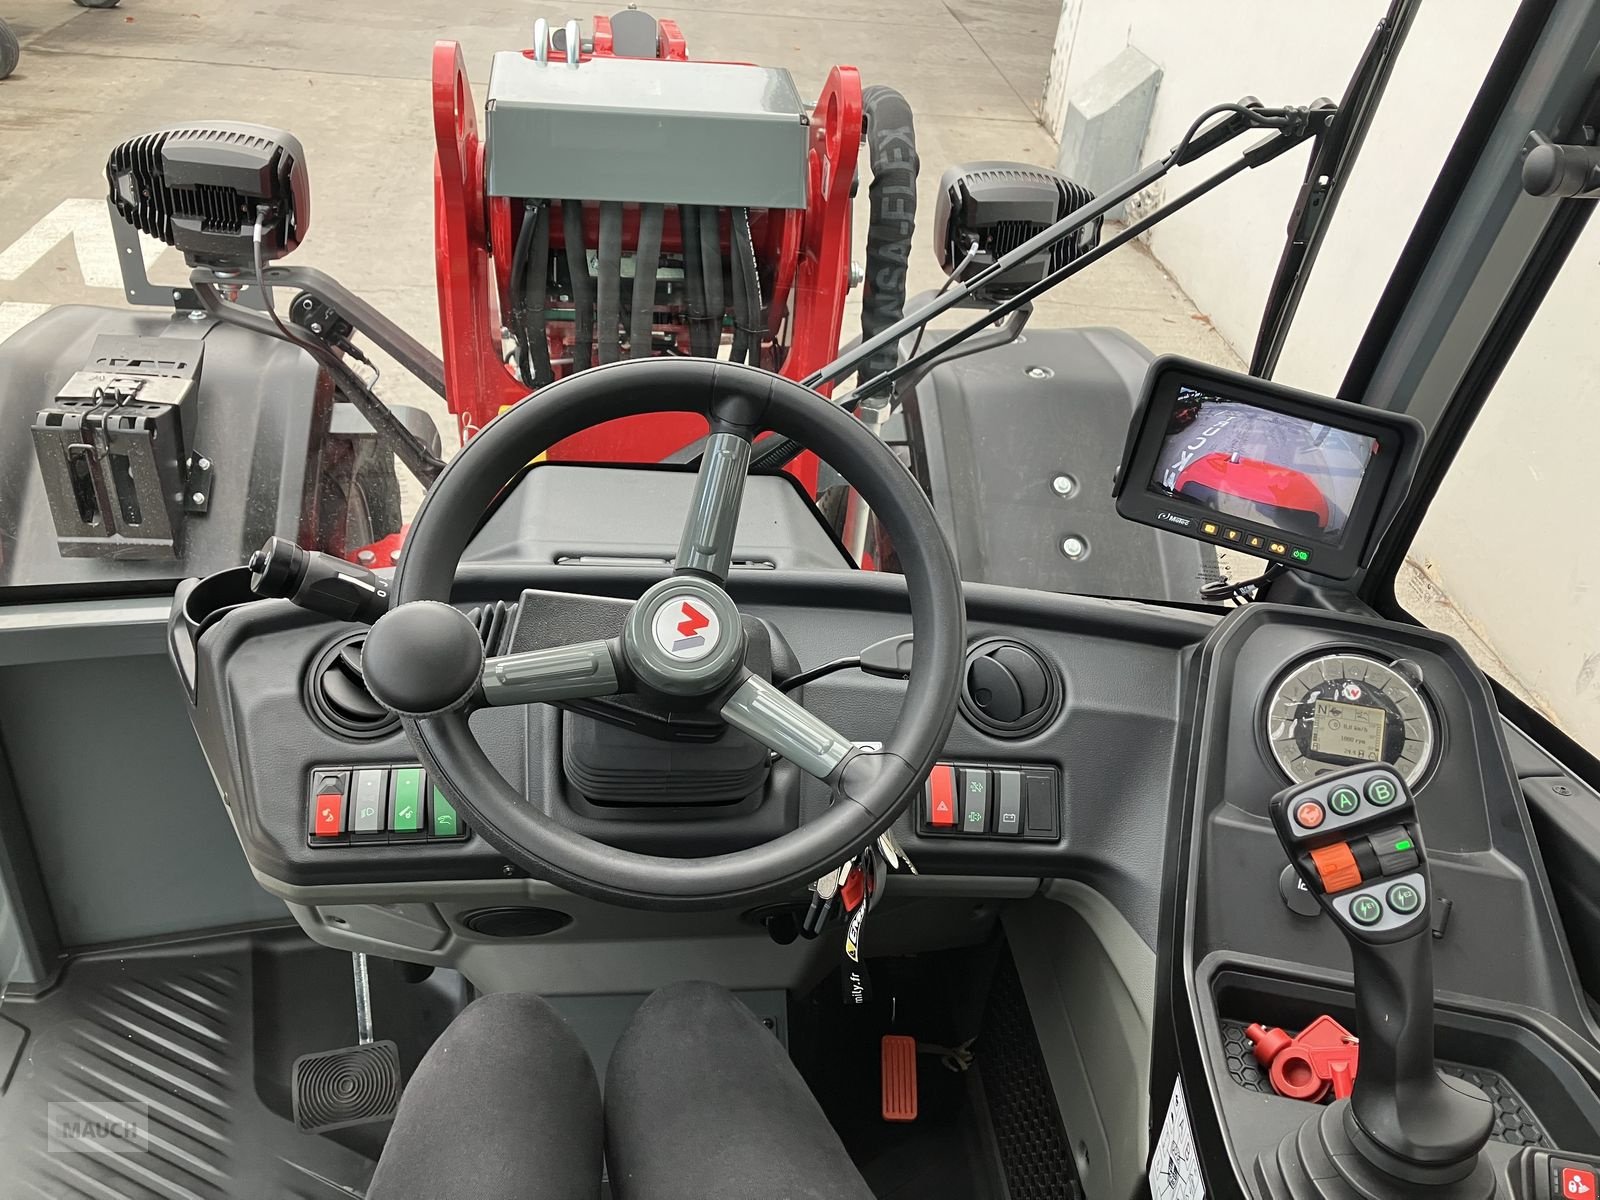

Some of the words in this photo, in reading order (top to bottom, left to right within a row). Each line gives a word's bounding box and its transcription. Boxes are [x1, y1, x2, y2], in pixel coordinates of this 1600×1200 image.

[1169, 514, 1191, 526] Motec
[1318, 704, 1328, 715] N
[1339, 793, 1353, 809] A
[1374, 785, 1391, 800] B
[1404, 890, 1413, 898] E2
[1366, 902, 1376, 910] E1
